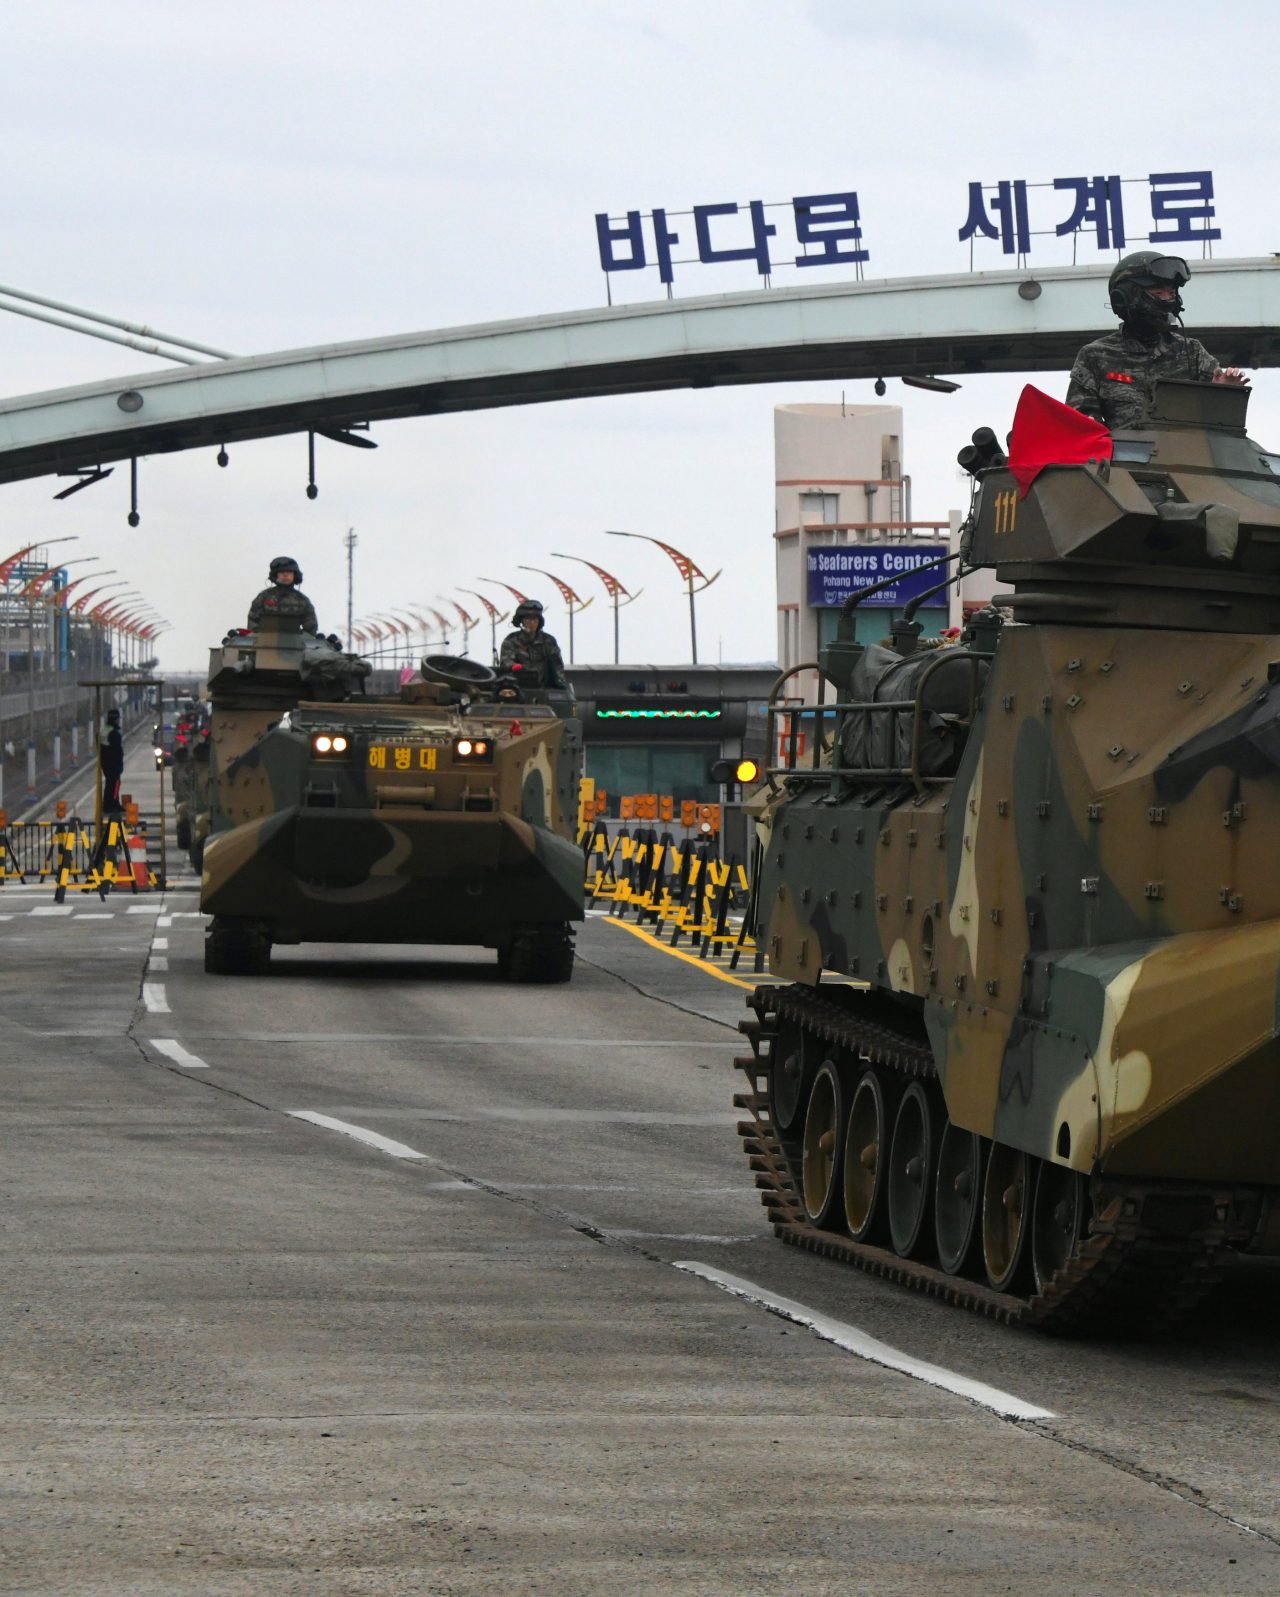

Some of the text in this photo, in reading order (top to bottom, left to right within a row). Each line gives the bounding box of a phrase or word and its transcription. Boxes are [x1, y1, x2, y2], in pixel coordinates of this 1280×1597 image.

[595, 191, 870, 283] 바다로
[957, 170, 1222, 255] 세계로
[994, 489, 1017, 534] 111
[818, 553, 878, 571] Seafarers
[823, 575, 851, 588] Pohang
[853, 575, 874, 586] New
